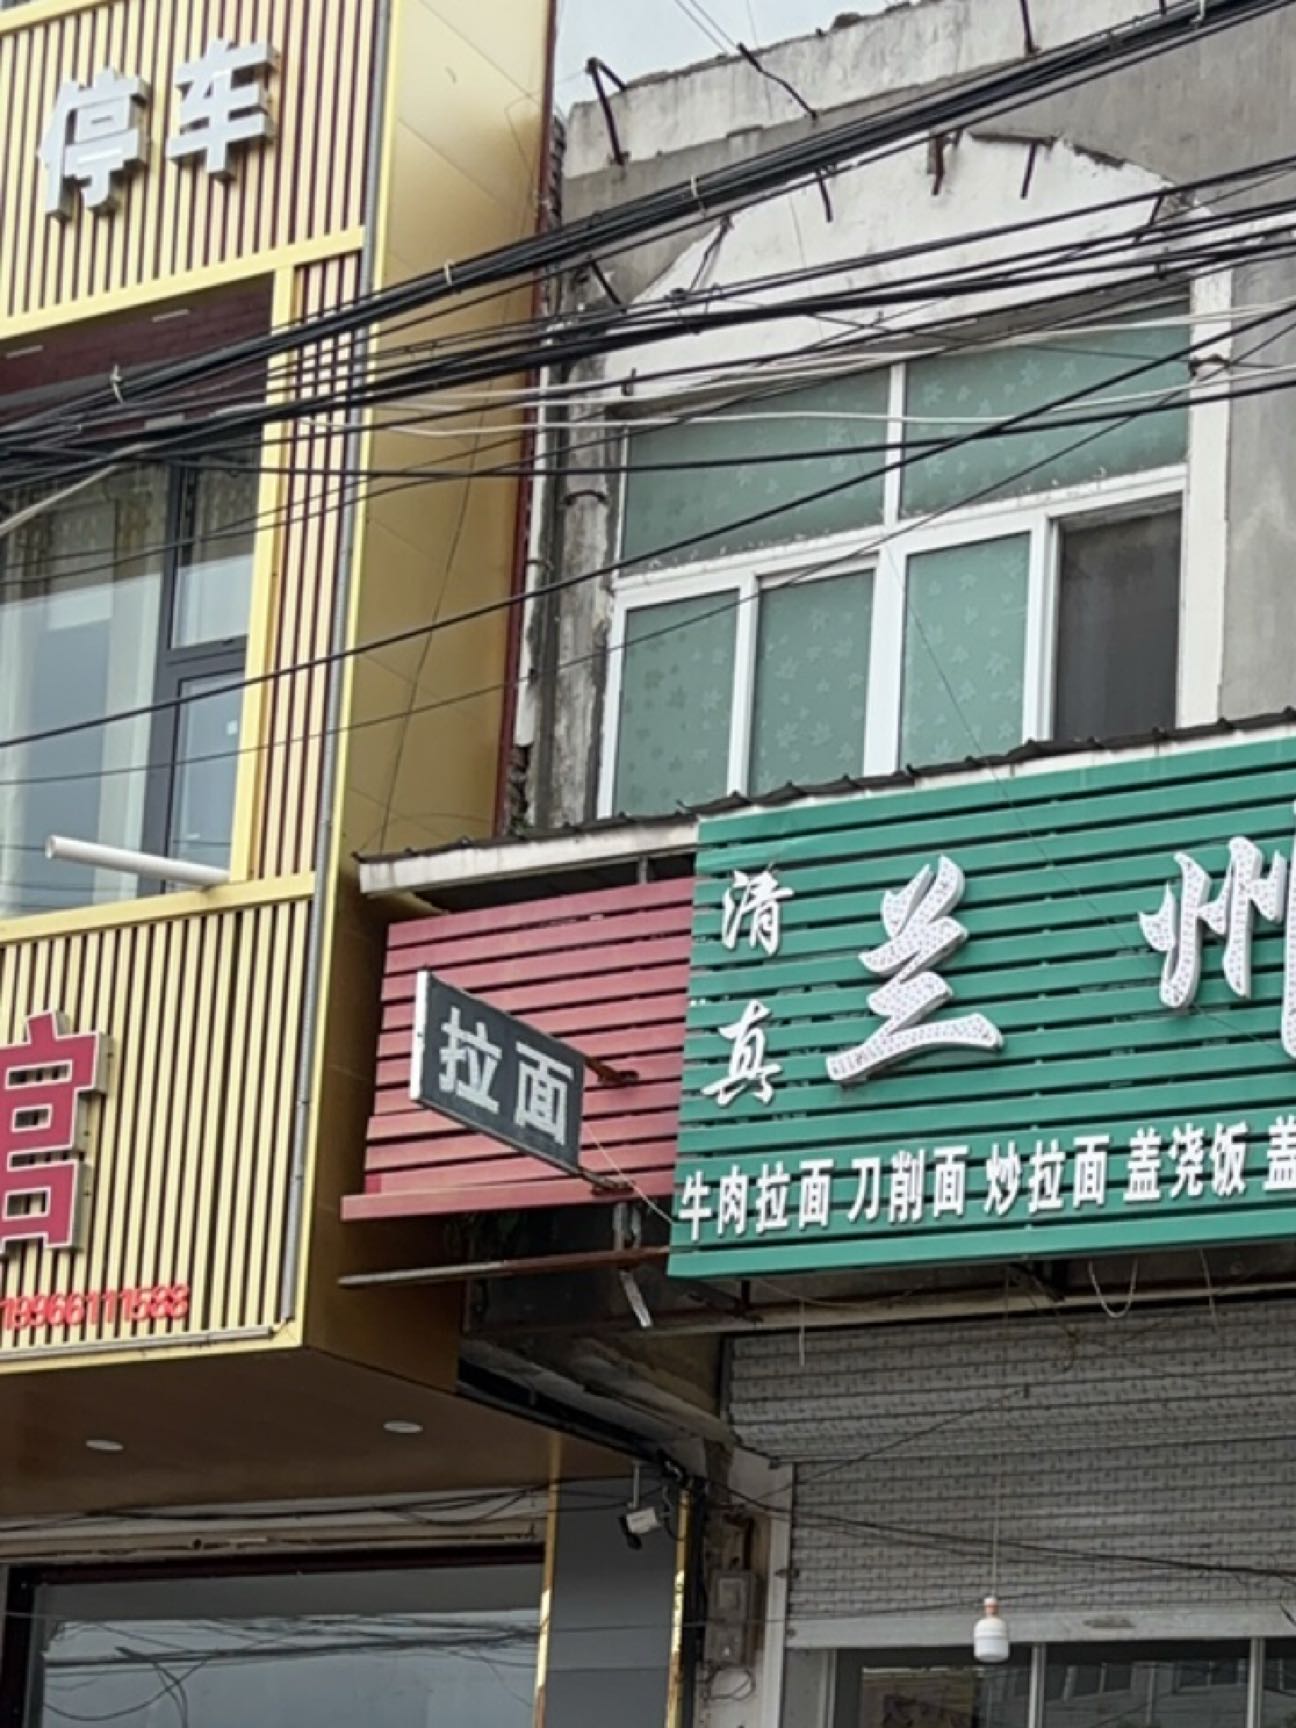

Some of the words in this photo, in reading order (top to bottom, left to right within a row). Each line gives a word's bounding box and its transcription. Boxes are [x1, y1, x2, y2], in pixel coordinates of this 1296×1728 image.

[37, 36, 276, 218] 停车
[700, 868, 796, 1108] 清真
[437, 1006, 575, 1146] 拉面
[677, 1158, 835, 1241] 牛肉拉面
[847, 1144, 970, 1223] 刀削面
[984, 1134, 1110, 1216] 炒拉面
[1122, 1120, 1249, 1201] 盖浇饭
